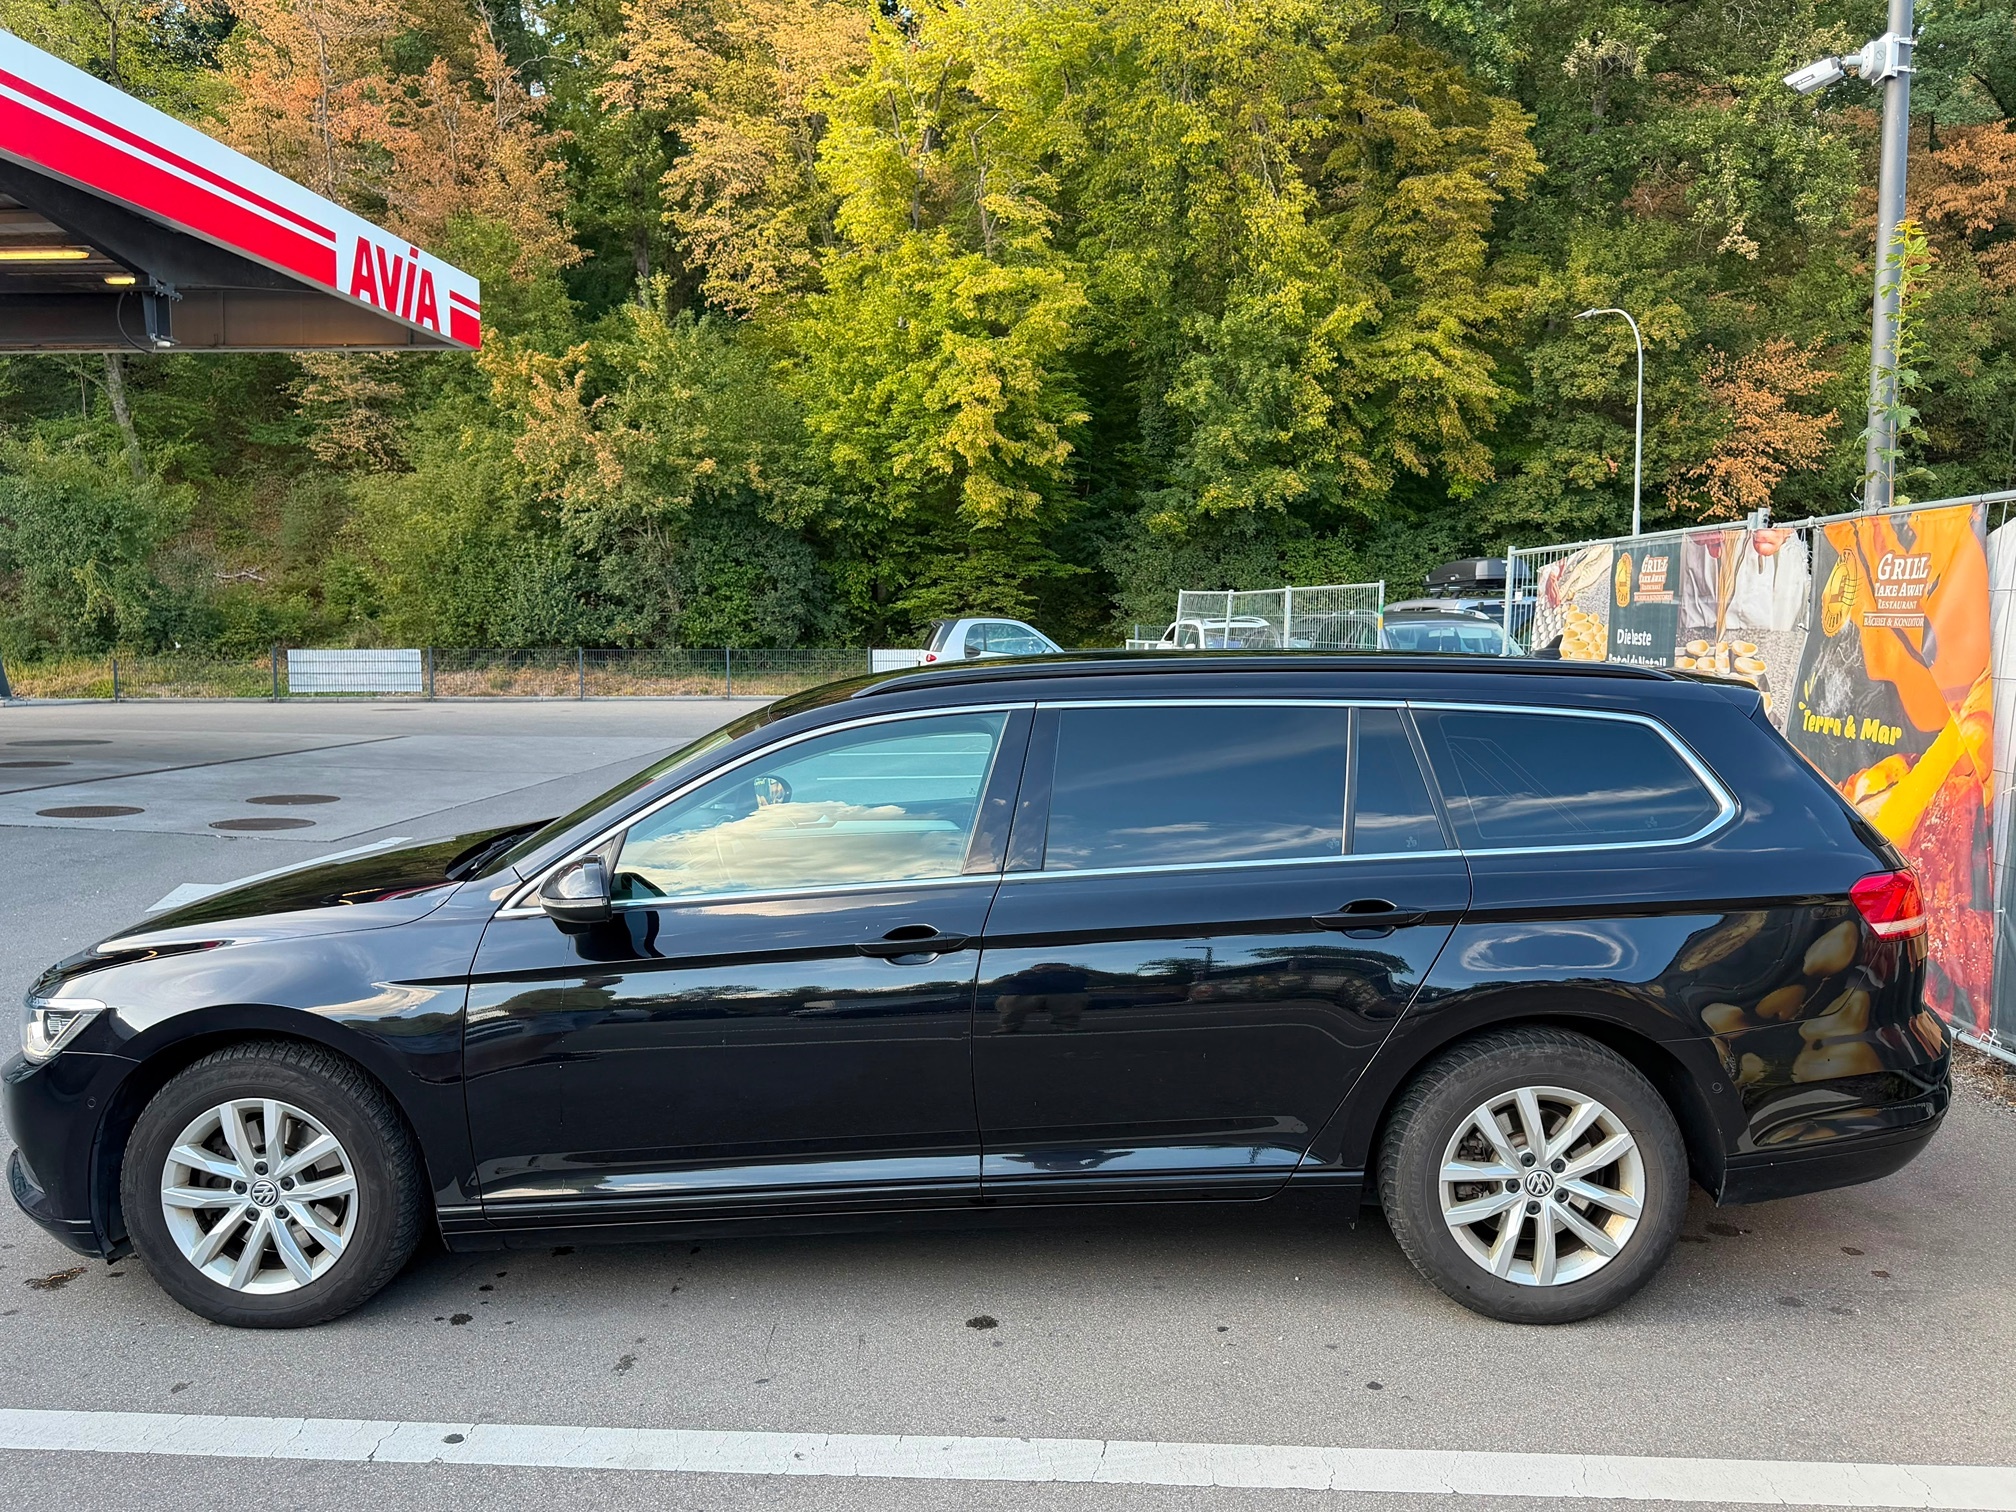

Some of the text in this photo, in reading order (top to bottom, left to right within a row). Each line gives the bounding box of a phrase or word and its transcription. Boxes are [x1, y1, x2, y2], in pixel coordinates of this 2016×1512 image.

[1877, 553, 1929, 580] GRILL
[1875, 582, 1924, 597] TAKE AWAY
[1617, 628, 1631, 645] Die
[1803, 709, 1902, 745] Terra & Mar
